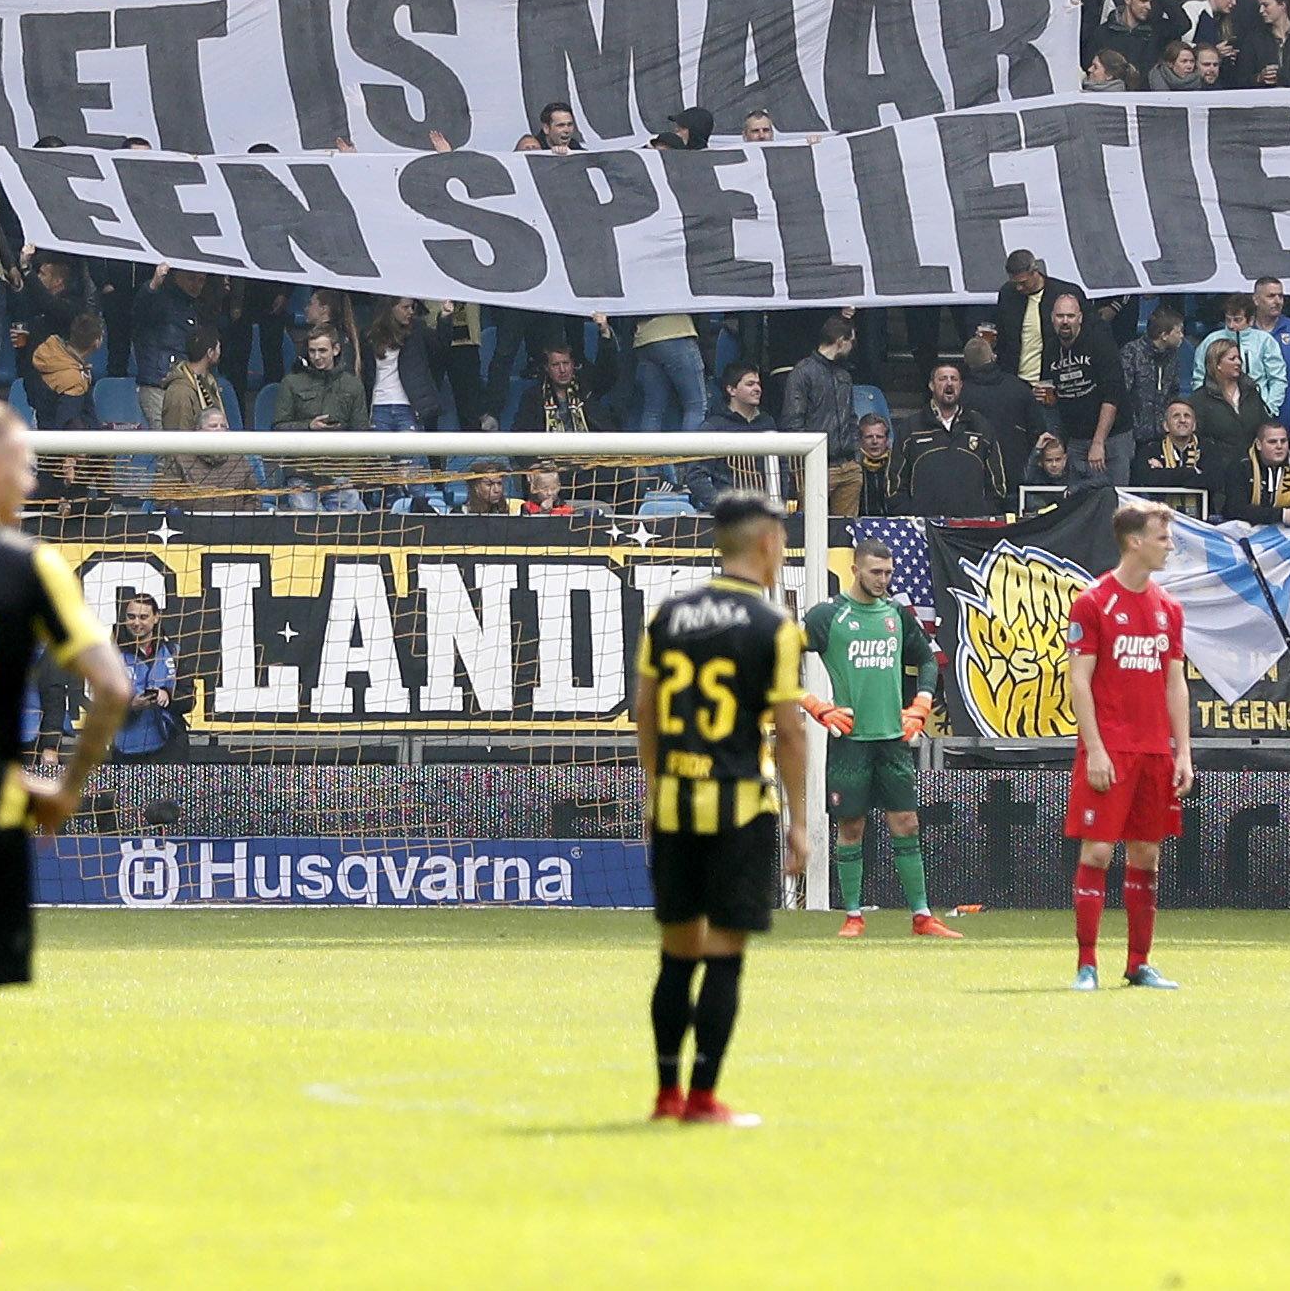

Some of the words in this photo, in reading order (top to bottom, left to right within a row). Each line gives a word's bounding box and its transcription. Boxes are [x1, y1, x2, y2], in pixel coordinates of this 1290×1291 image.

[17, 147, 379, 278] EEN
[848, 640, 887, 661] pure
[855, 656, 895, 670] energie
[1112, 635, 1156, 660] pure
[657, 650, 738, 742] 25
[199, 841, 574, 903] Husqvarna
